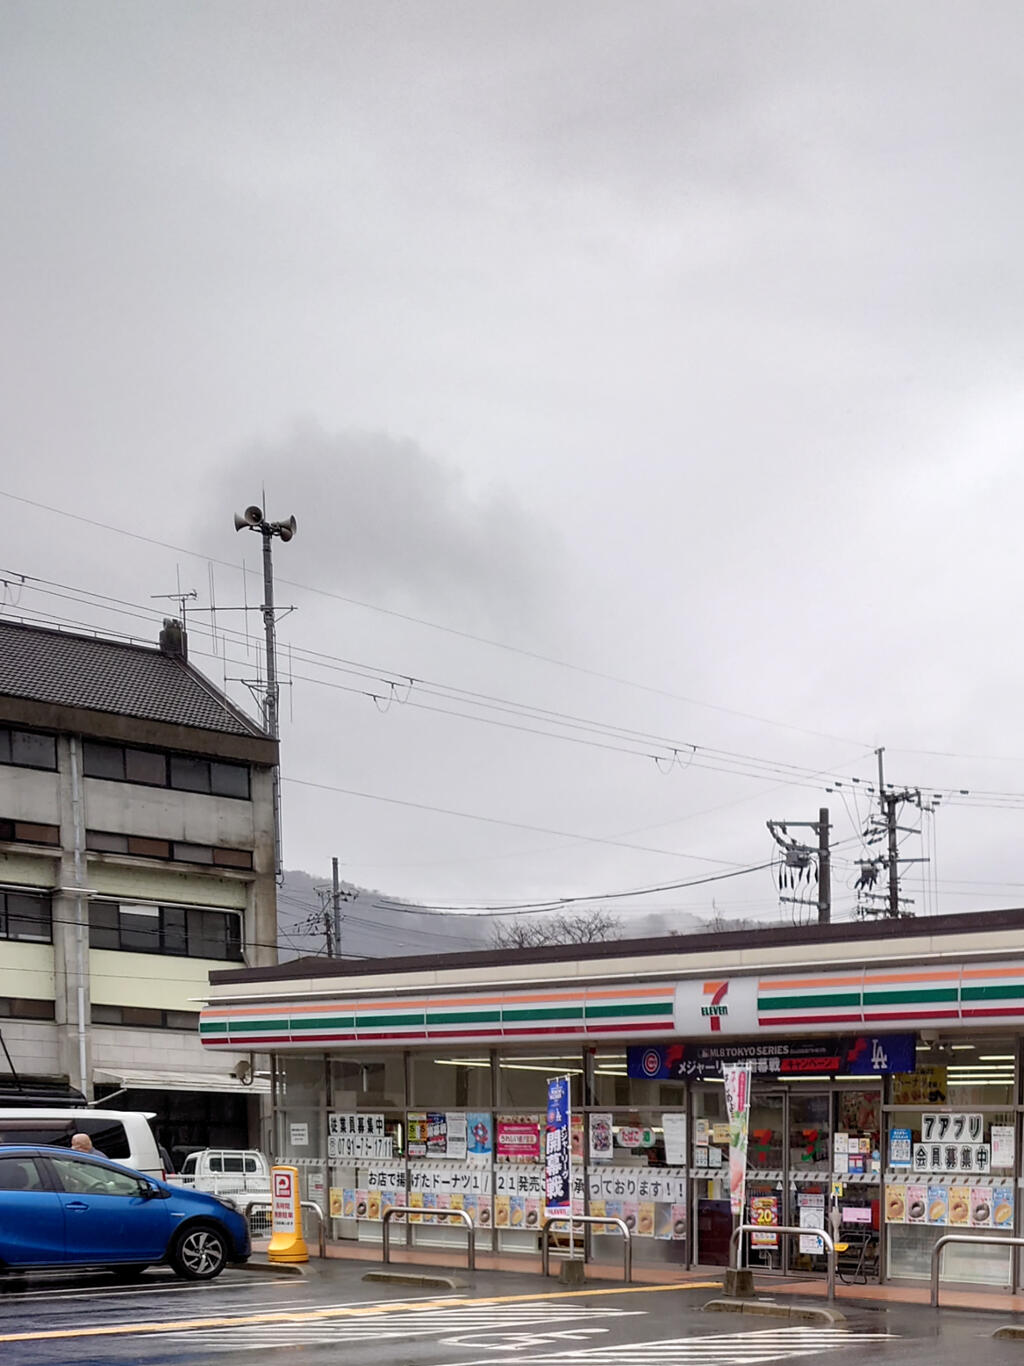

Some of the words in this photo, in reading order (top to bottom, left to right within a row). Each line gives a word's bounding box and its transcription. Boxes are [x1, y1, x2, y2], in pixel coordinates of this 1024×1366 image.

[725, 1046, 756, 1057] TOKYO
[756, 1045, 789, 1056] SERIES
[331, 1116, 383, 1134] 従業員募集中
[924, 1115, 981, 1140] 7アプリ
[547, 1129, 564, 1200] 開幕戦
[915, 1145, 988, 1170] 会員募集中
[276, 1175, 290, 1196] P
